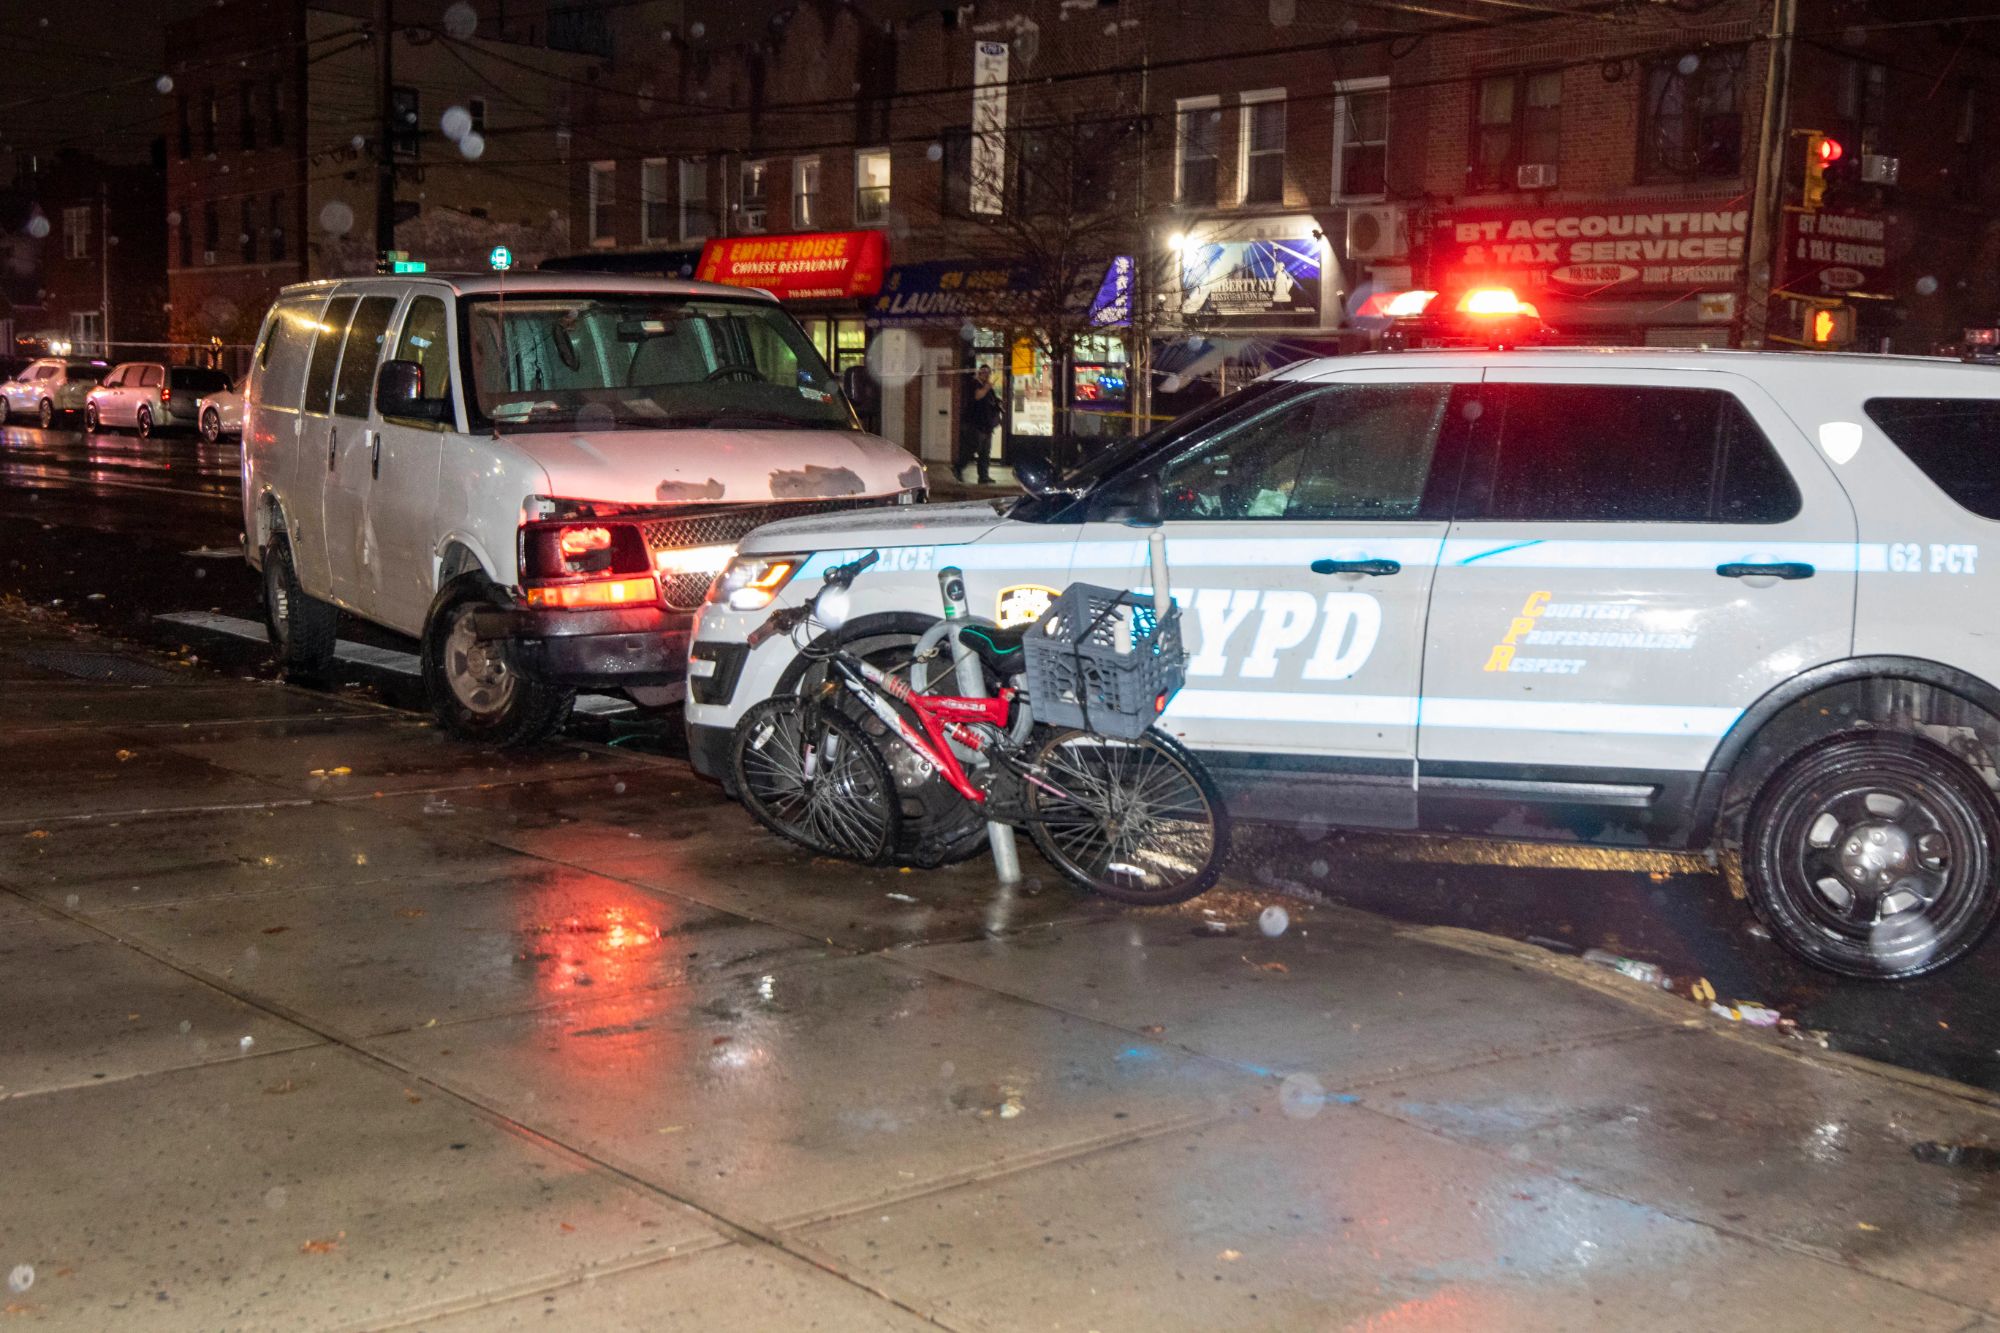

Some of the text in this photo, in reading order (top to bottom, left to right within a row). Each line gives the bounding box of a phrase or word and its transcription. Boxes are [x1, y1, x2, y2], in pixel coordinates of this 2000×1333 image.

[1456, 221, 1502, 242] BT
[730, 238, 847, 261] EMPIRE HOUSE
[1463, 237, 1743, 264] & TAX SERVICES
[732, 258, 848, 274] CHINESE RESTAURANT
[842, 547, 935, 573] PLICE
[1889, 542, 1978, 574] 62 PCT
[1134, 586, 1382, 680] YPD
[1484, 645, 1587, 674] RESPECT
